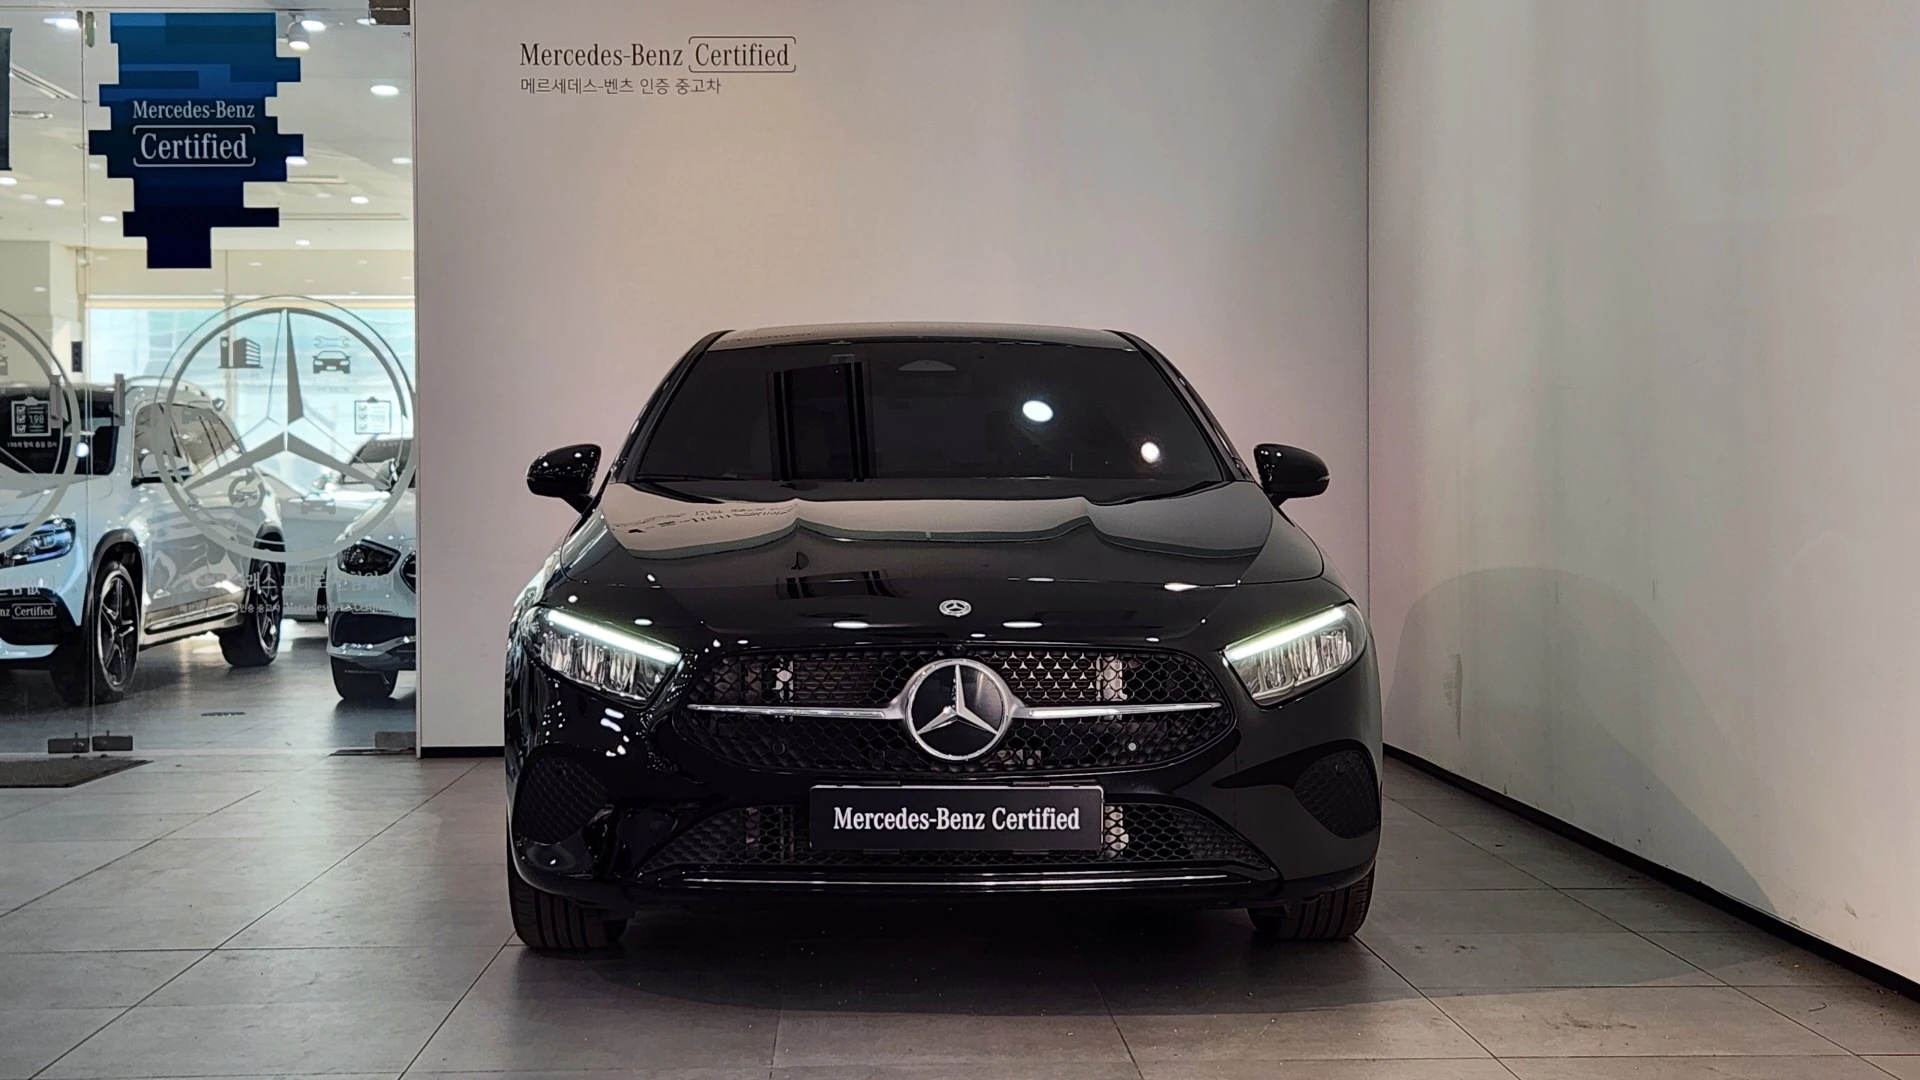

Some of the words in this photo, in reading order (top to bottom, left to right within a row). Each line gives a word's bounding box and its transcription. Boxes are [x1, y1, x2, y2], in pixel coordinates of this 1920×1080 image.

[519, 43, 683, 67] Mercedes-Benz
[695, 43, 789, 67] Certified
[520, 77, 635, 95] 메르세데스-벤츠
[639, 78, 671, 95] 인증
[674, 78, 722, 95] 중고차
[132, 100, 255, 119] Mercedes-Benz
[140, 132, 248, 160] Certified
[29, 414, 45, 424] 198
[14, 606, 54, 617] Certified
[833, 806, 986, 830] Mercedes-Benz
[991, 807, 1081, 830] Certified
